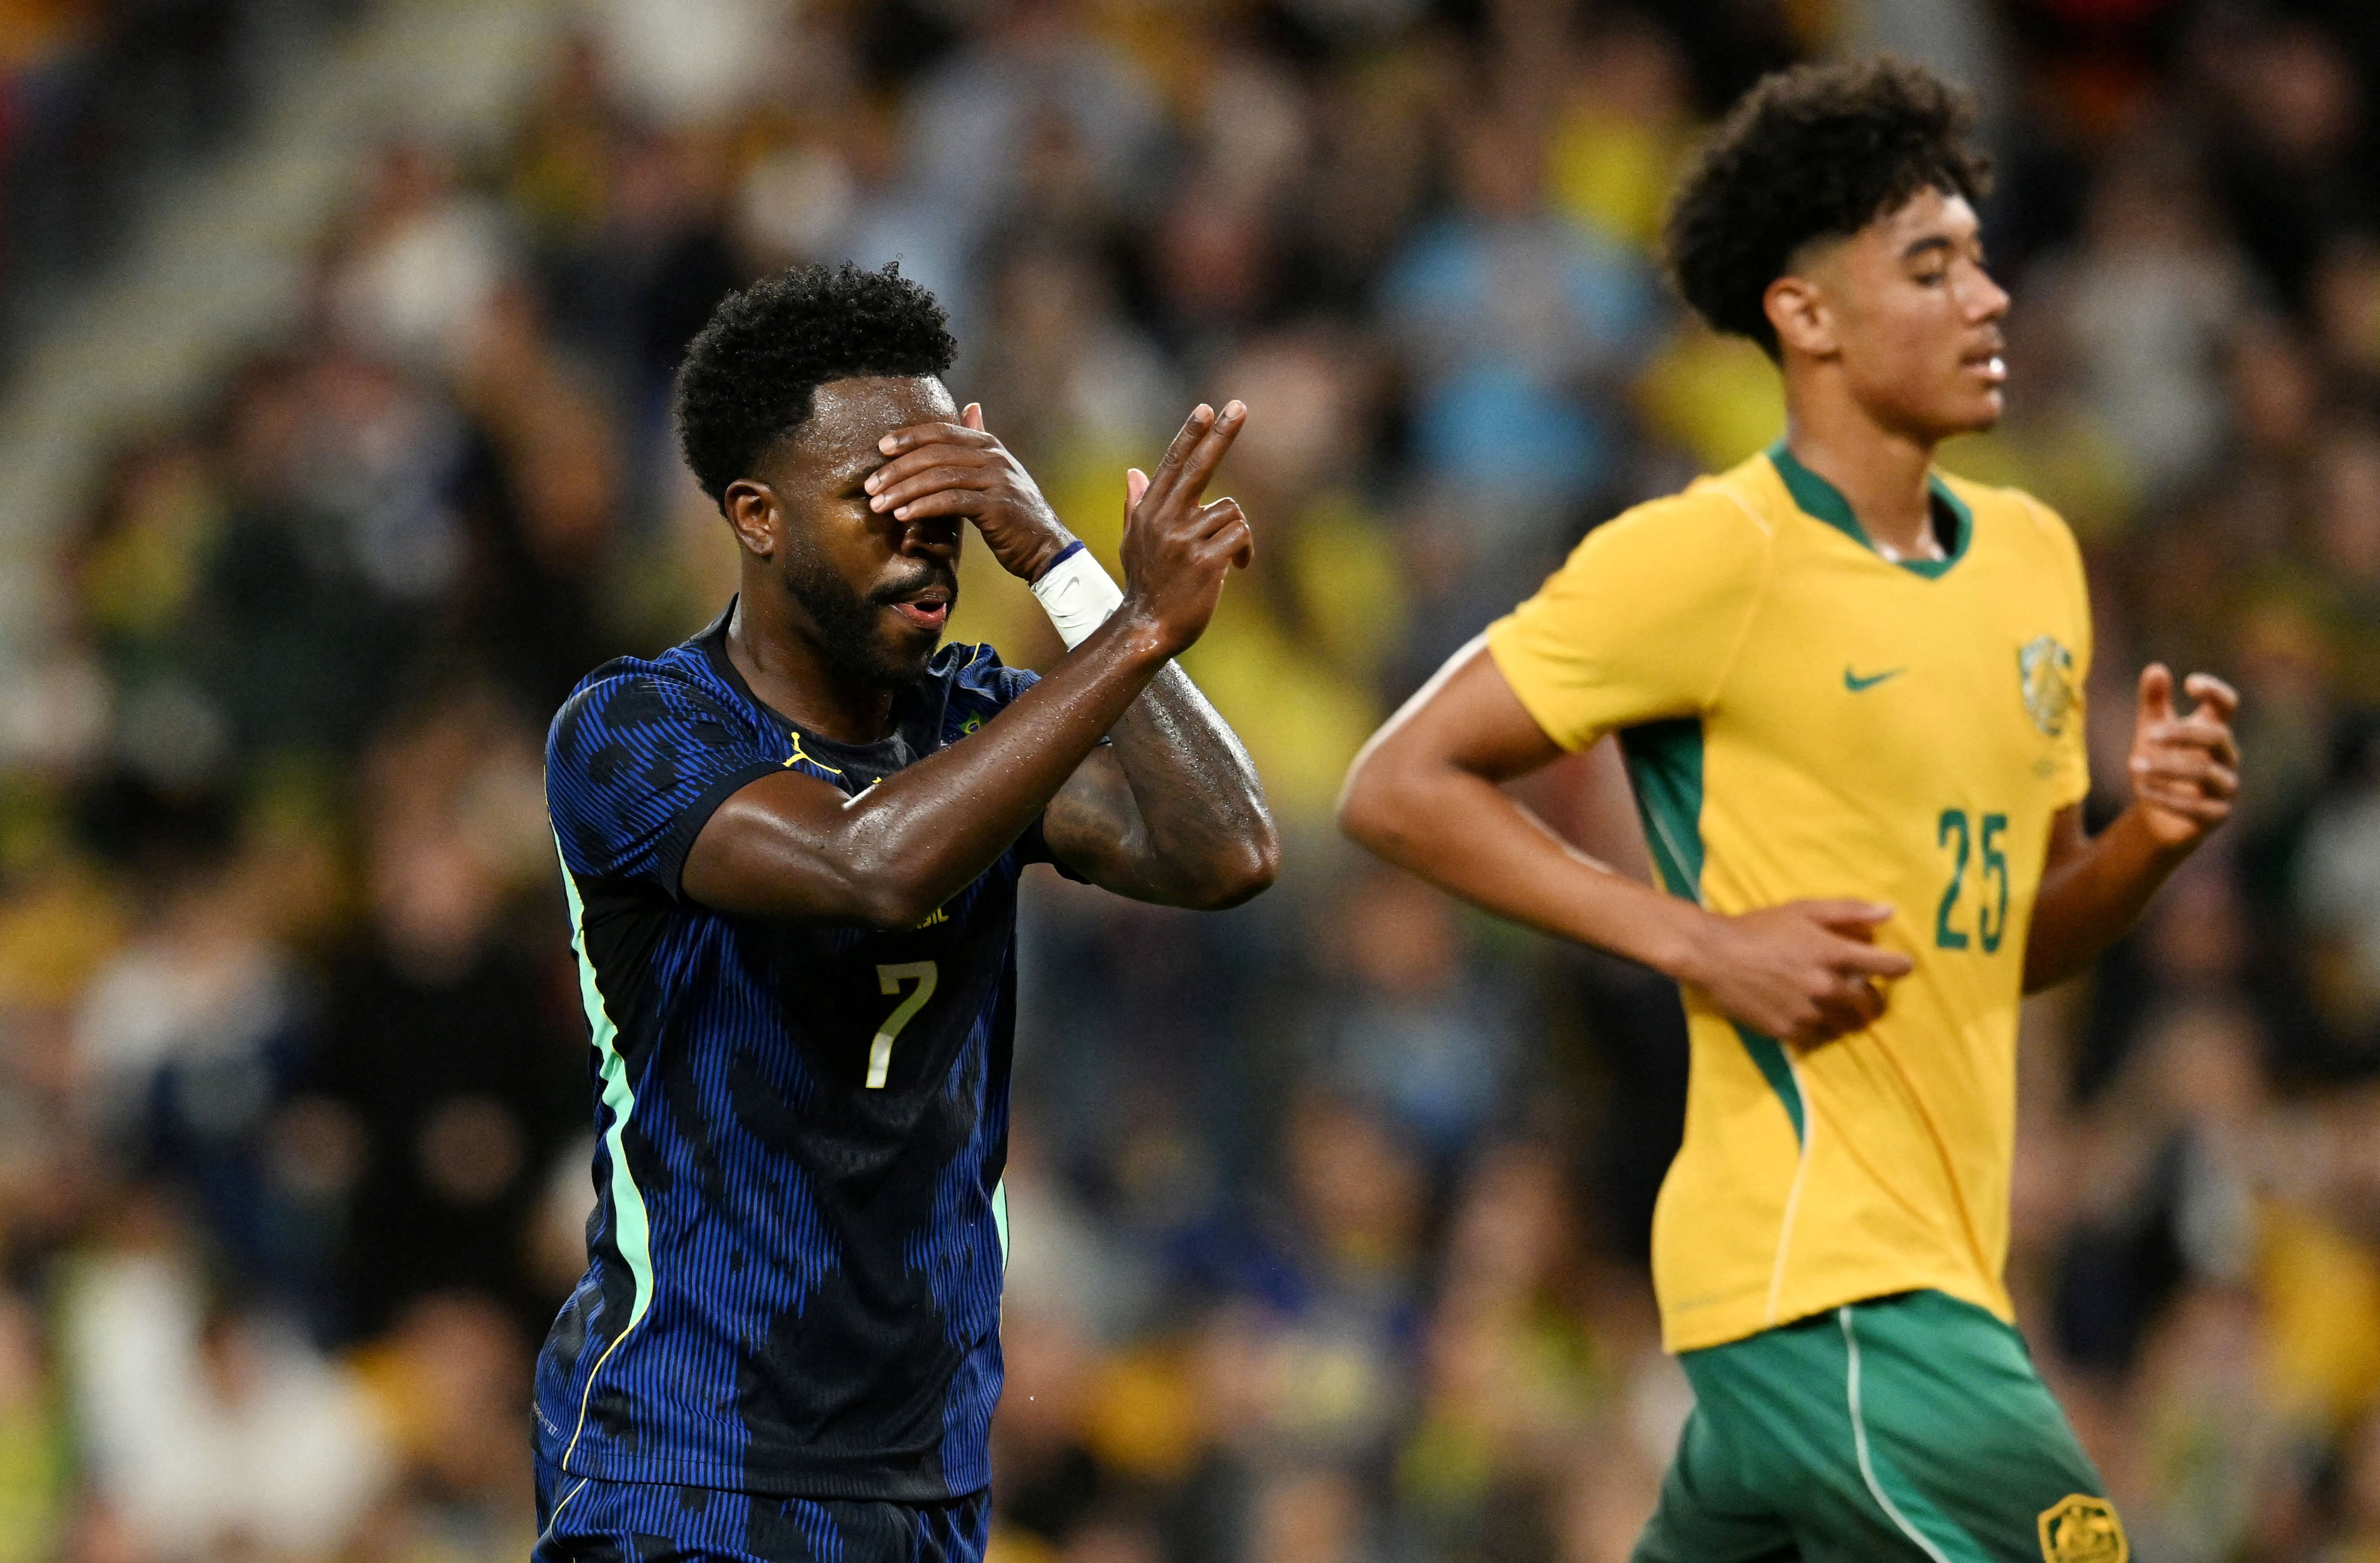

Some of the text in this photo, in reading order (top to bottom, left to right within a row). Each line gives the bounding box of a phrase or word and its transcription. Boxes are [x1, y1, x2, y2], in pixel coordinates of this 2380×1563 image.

[916, 907, 949, 929] SIL
[1936, 808, 2009, 953] 25
[865, 960, 938, 1089] 7
